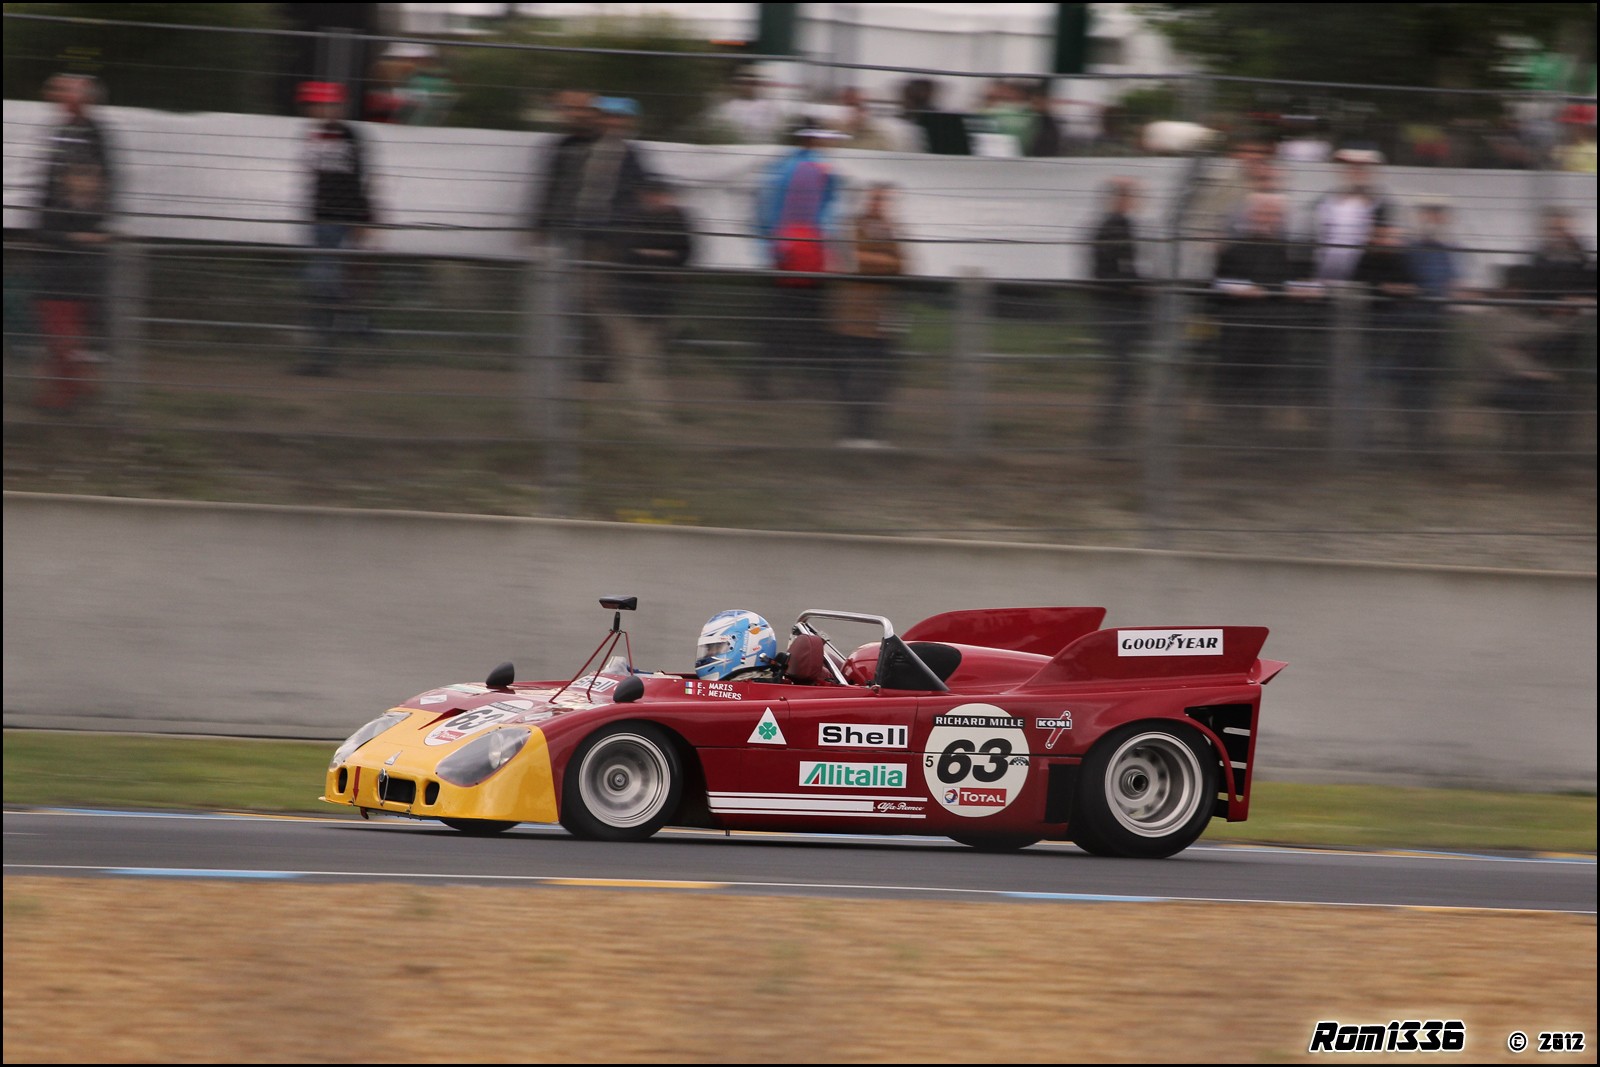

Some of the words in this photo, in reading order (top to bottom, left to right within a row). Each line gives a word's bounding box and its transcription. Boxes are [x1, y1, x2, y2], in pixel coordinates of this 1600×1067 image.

[709, 683, 733, 692] MARIS
[697, 689, 706, 697] F.
[708, 690, 742, 700] MEINERS
[935, 716, 986, 727] RICHARD
[989, 717, 1024, 727] MILLE
[1038, 720, 1071, 728] KONI
[822, 726, 906, 746] Shell
[925, 756, 934, 768] 5
[937, 738, 1013, 784] 63
[803, 763, 903, 787] Alitalia
[961, 791, 1005, 803] TOTAL
